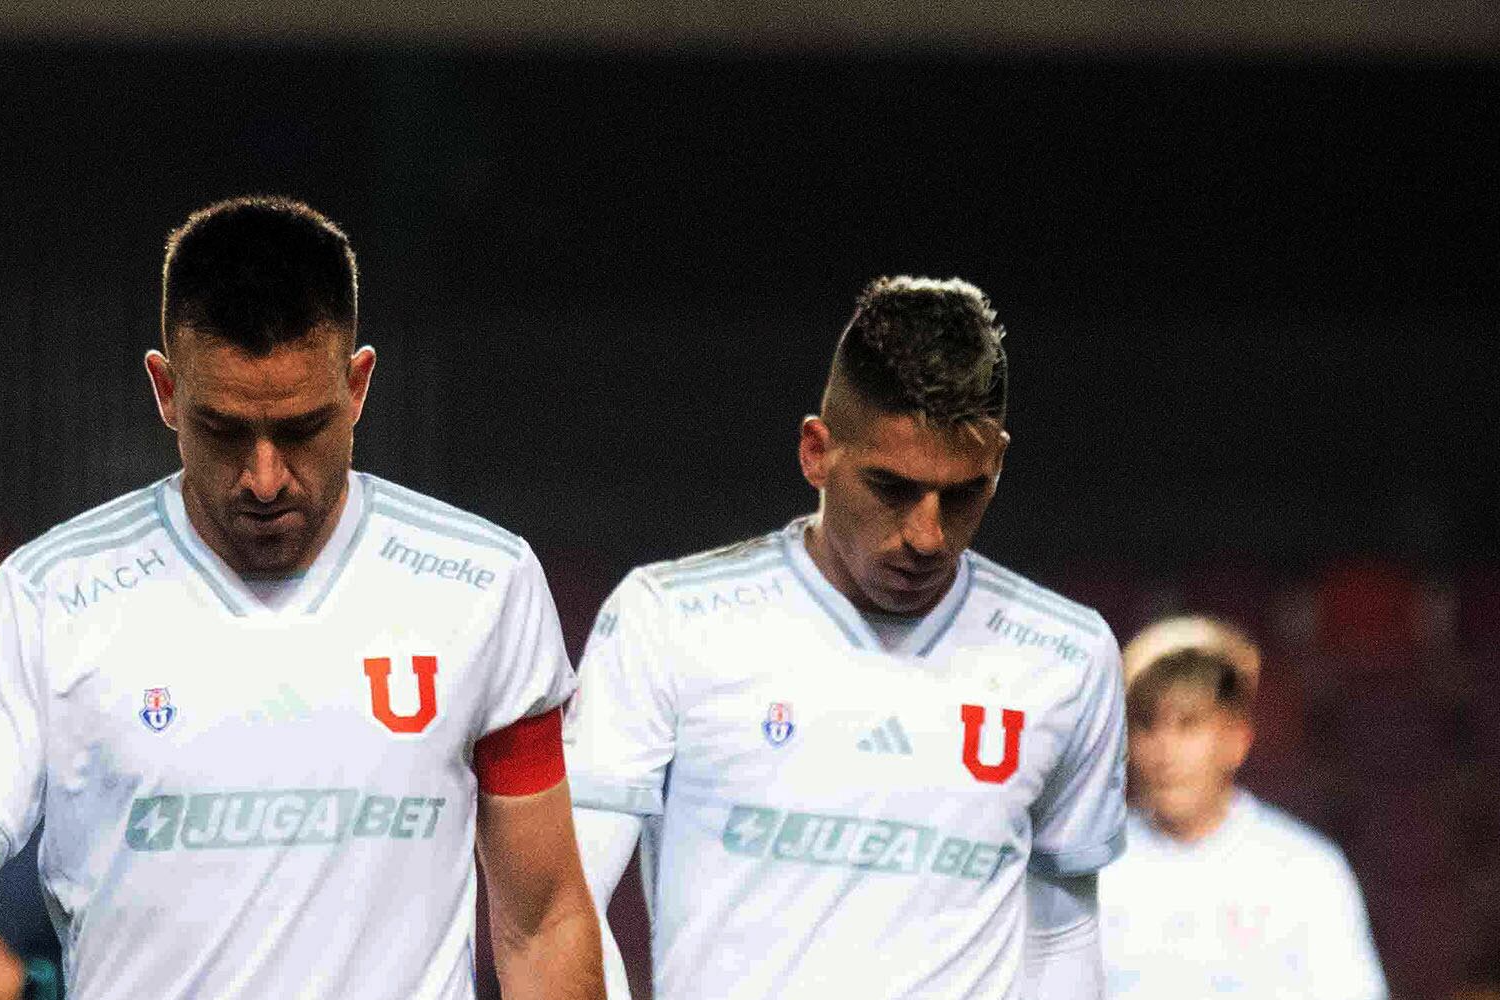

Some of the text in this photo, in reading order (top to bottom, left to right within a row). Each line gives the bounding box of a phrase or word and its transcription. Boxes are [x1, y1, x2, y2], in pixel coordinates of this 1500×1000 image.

[57, 549, 166, 614] MACH
[379, 536, 496, 591] Impeke
[364, 656, 437, 734] U
[961, 703, 1025, 785] U
